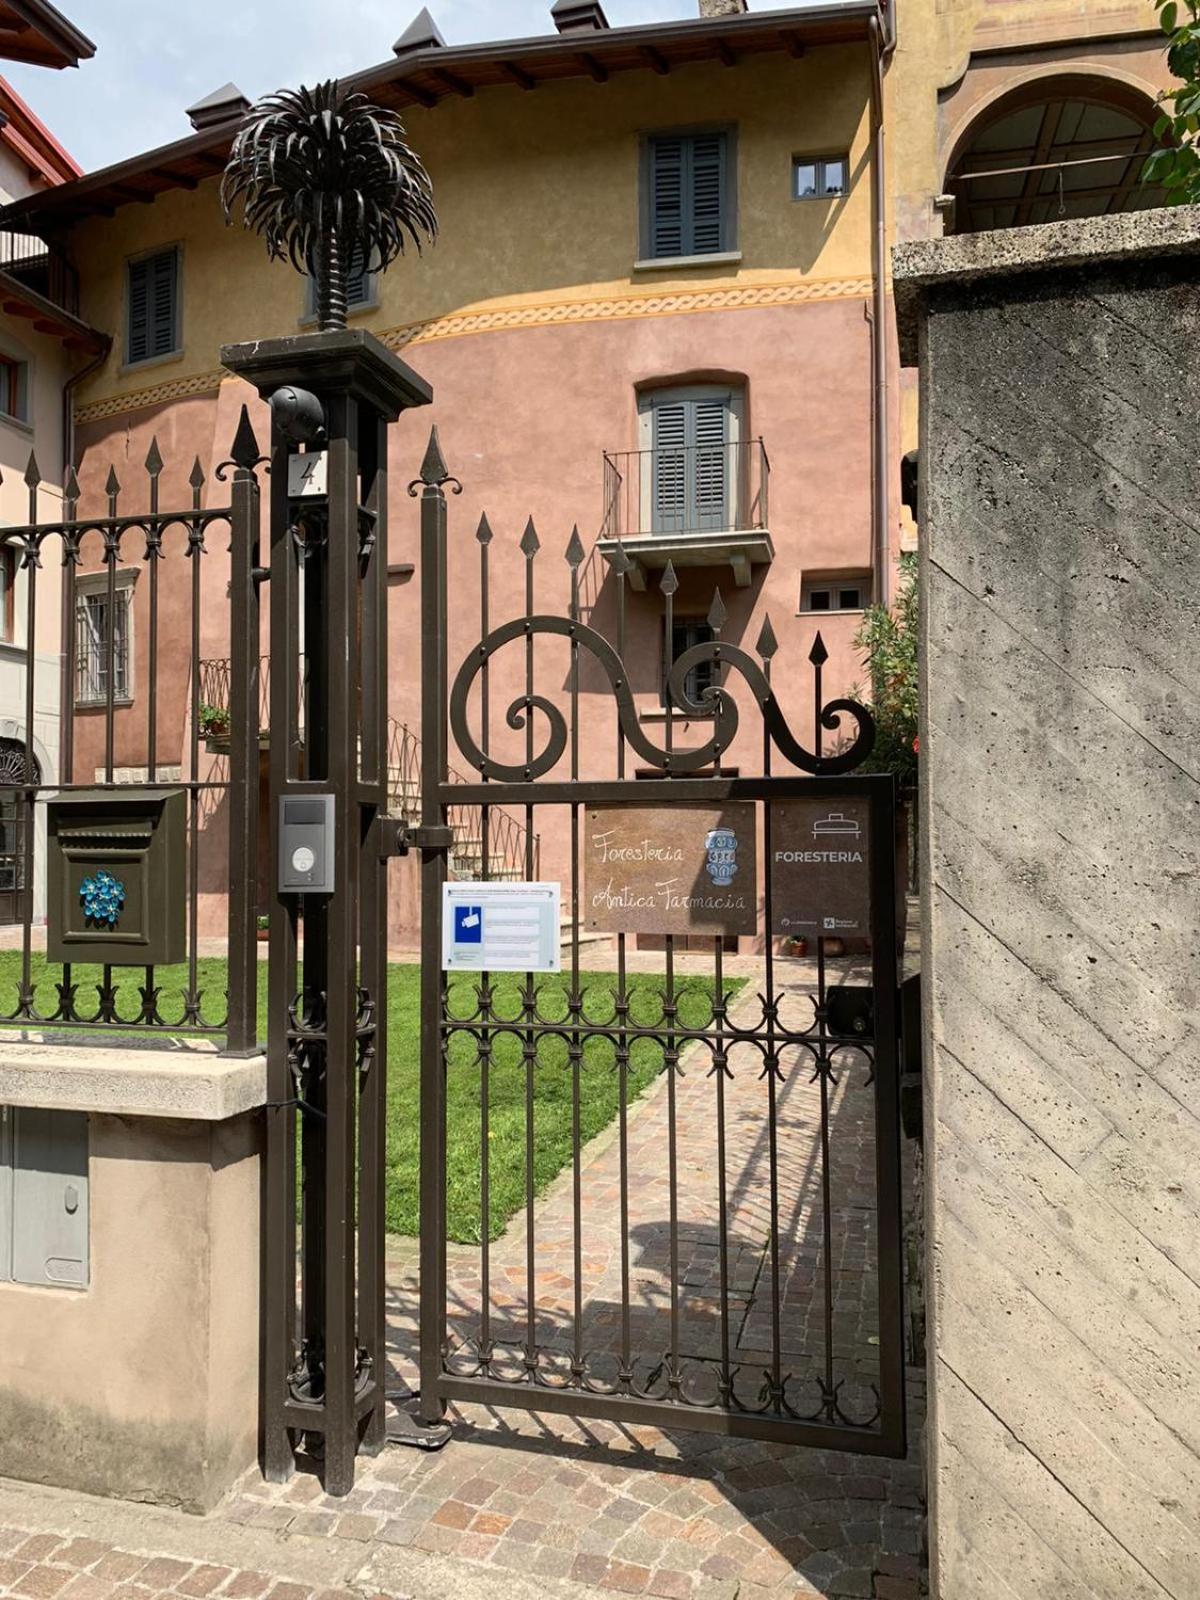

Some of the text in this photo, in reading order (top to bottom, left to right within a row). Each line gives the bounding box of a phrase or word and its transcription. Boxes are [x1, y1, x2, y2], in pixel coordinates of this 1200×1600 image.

[300, 462, 315, 485] 4
[592, 828, 684, 862] Foresteria
[775, 851, 863, 863] FORESTERIA
[592, 878, 746, 910] Antica Farmacia
